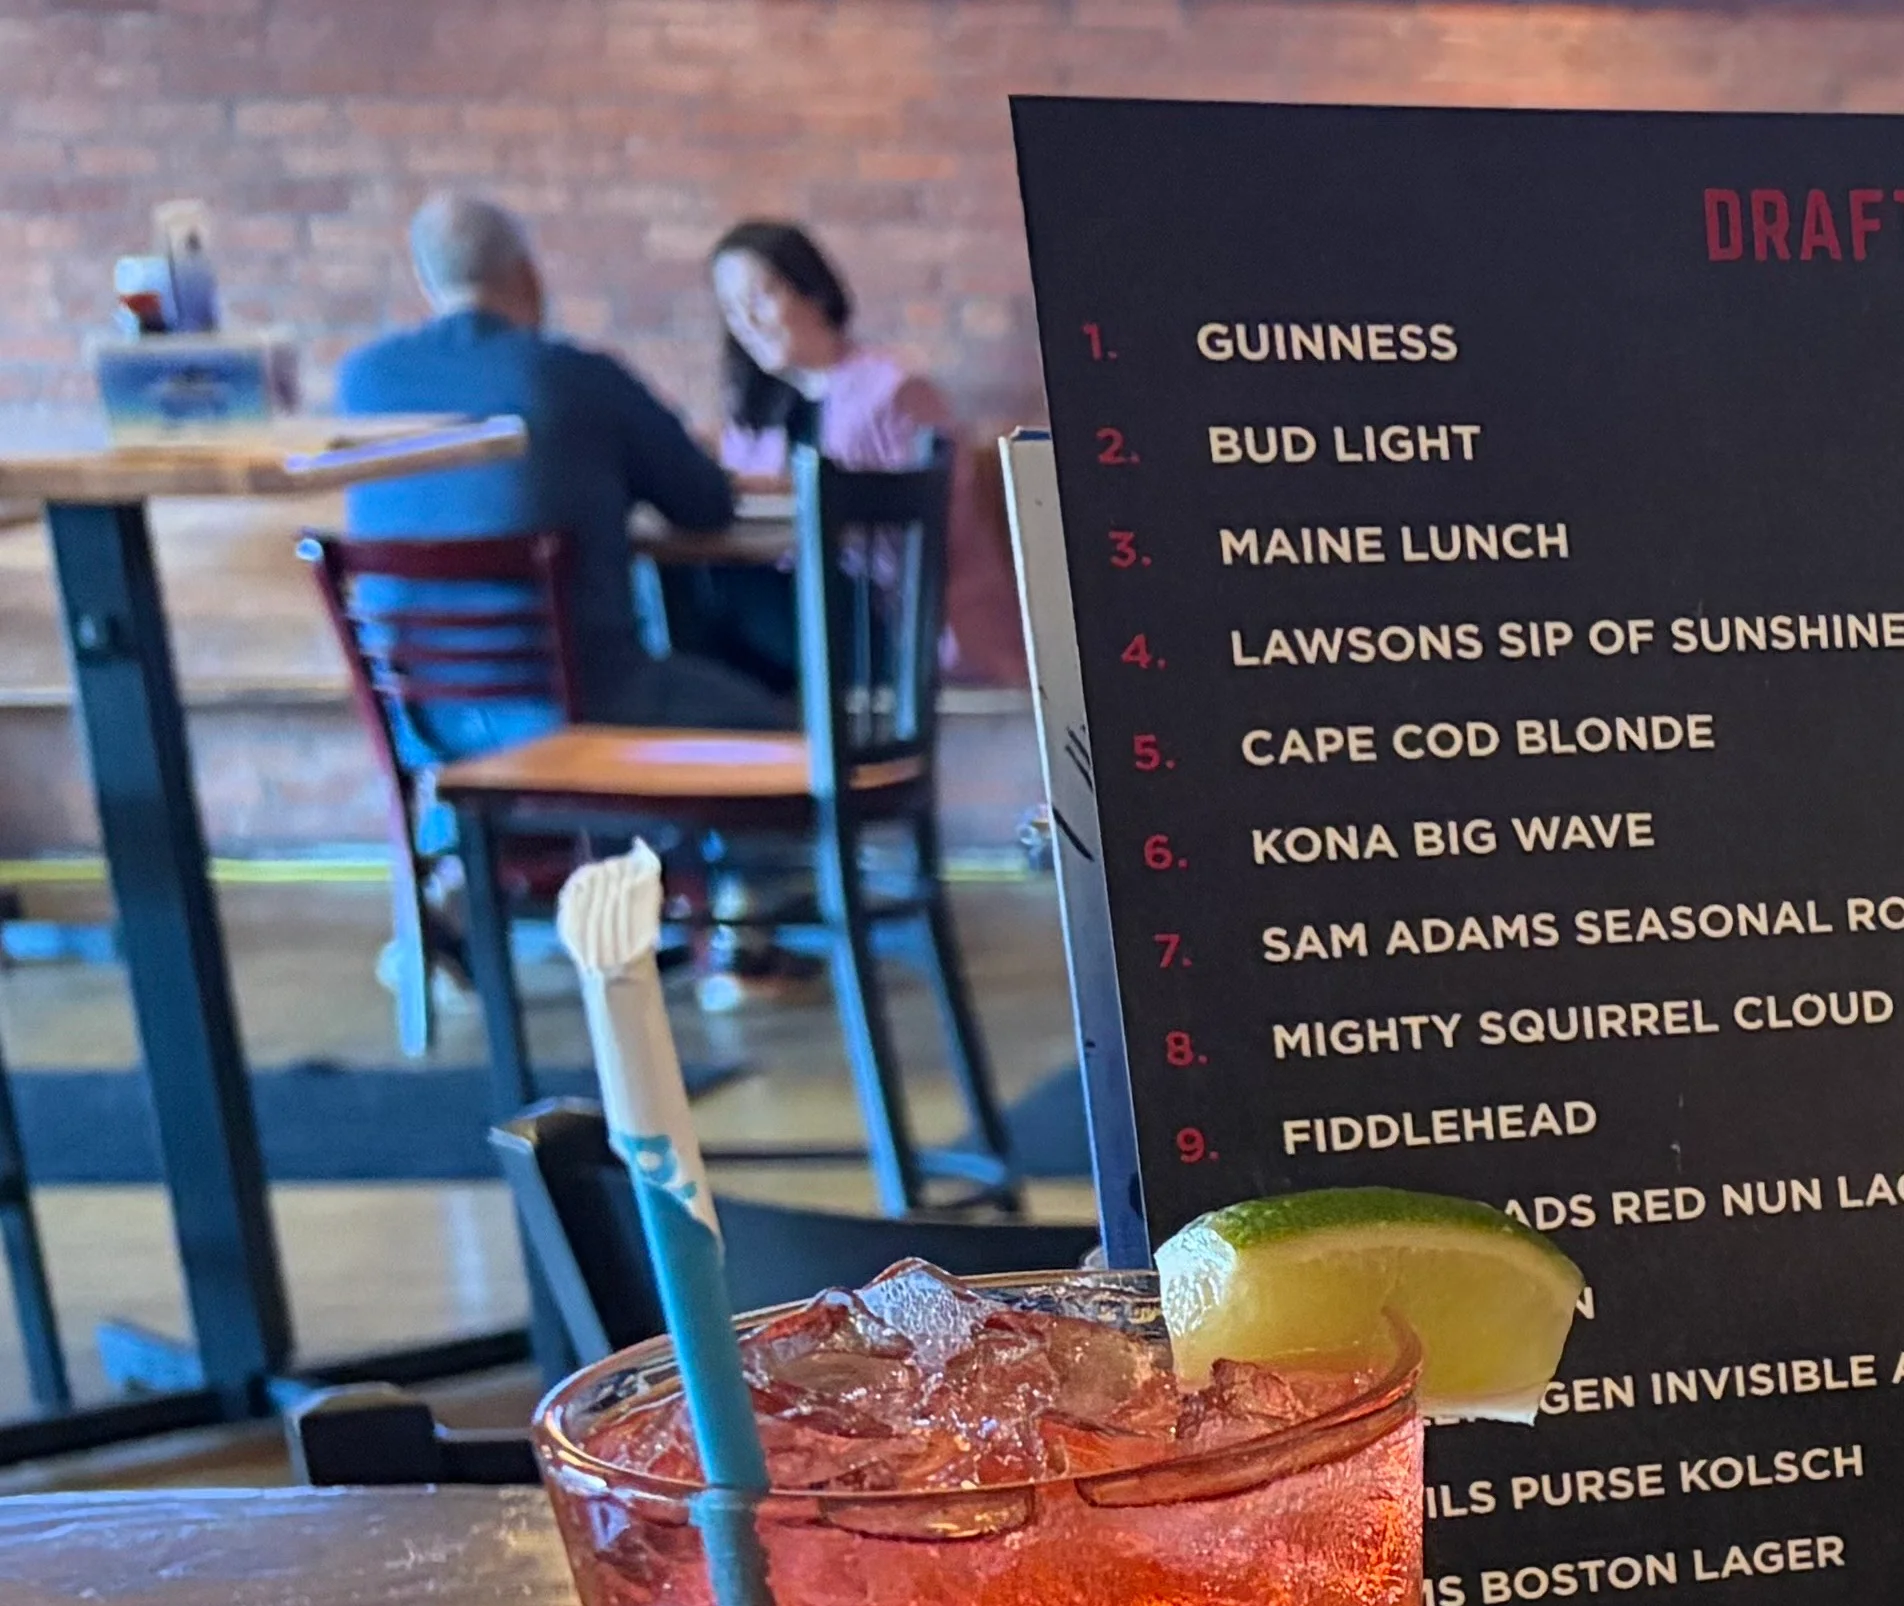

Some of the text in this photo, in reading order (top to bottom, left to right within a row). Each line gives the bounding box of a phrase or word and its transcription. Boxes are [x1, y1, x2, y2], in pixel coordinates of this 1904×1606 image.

[1081, 322, 1458, 361] 1. GUINNESS
[1095, 424, 1481, 466] 2. BUD LIGHT
[1110, 522, 1569, 570] 3. MAINE LUNCH
[1121, 634, 1167, 669] 4.
[1231, 623, 1483, 666] LAWSONS
[1498, 621, 1574, 658] SIP
[1588, 619, 1655, 655] OF
[1132, 714, 1715, 772] 5. CAPE COD BLONDE
[1143, 812, 1655, 871] 6. KONA BIG WAVE
[1154, 932, 1193, 969] 7.
[1262, 922, 1368, 962] SAM
[1385, 912, 1560, 955] ADAMS
[1574, 900, 1833, 945] SEASONAL
[1166, 1030, 1208, 1068] 8.
[1272, 1013, 1462, 1059] MIGHTY
[1479, 999, 1720, 1045] SQUIRREL
[1733, 990, 1894, 1030] CLOUD
[1175, 1100, 1597, 1165] 9. FIDDLEHEAD
[1611, 1186, 1706, 1225] RED
[1722, 1177, 1822, 1217] NUN
[1651, 1354, 1877, 1405] INVISIBLE
[1511, 1444, 1864, 1510] PURSE KOLSCH
[1480, 1551, 1678, 1605] BOSTON
[1693, 1535, 1845, 1581] LAGER
